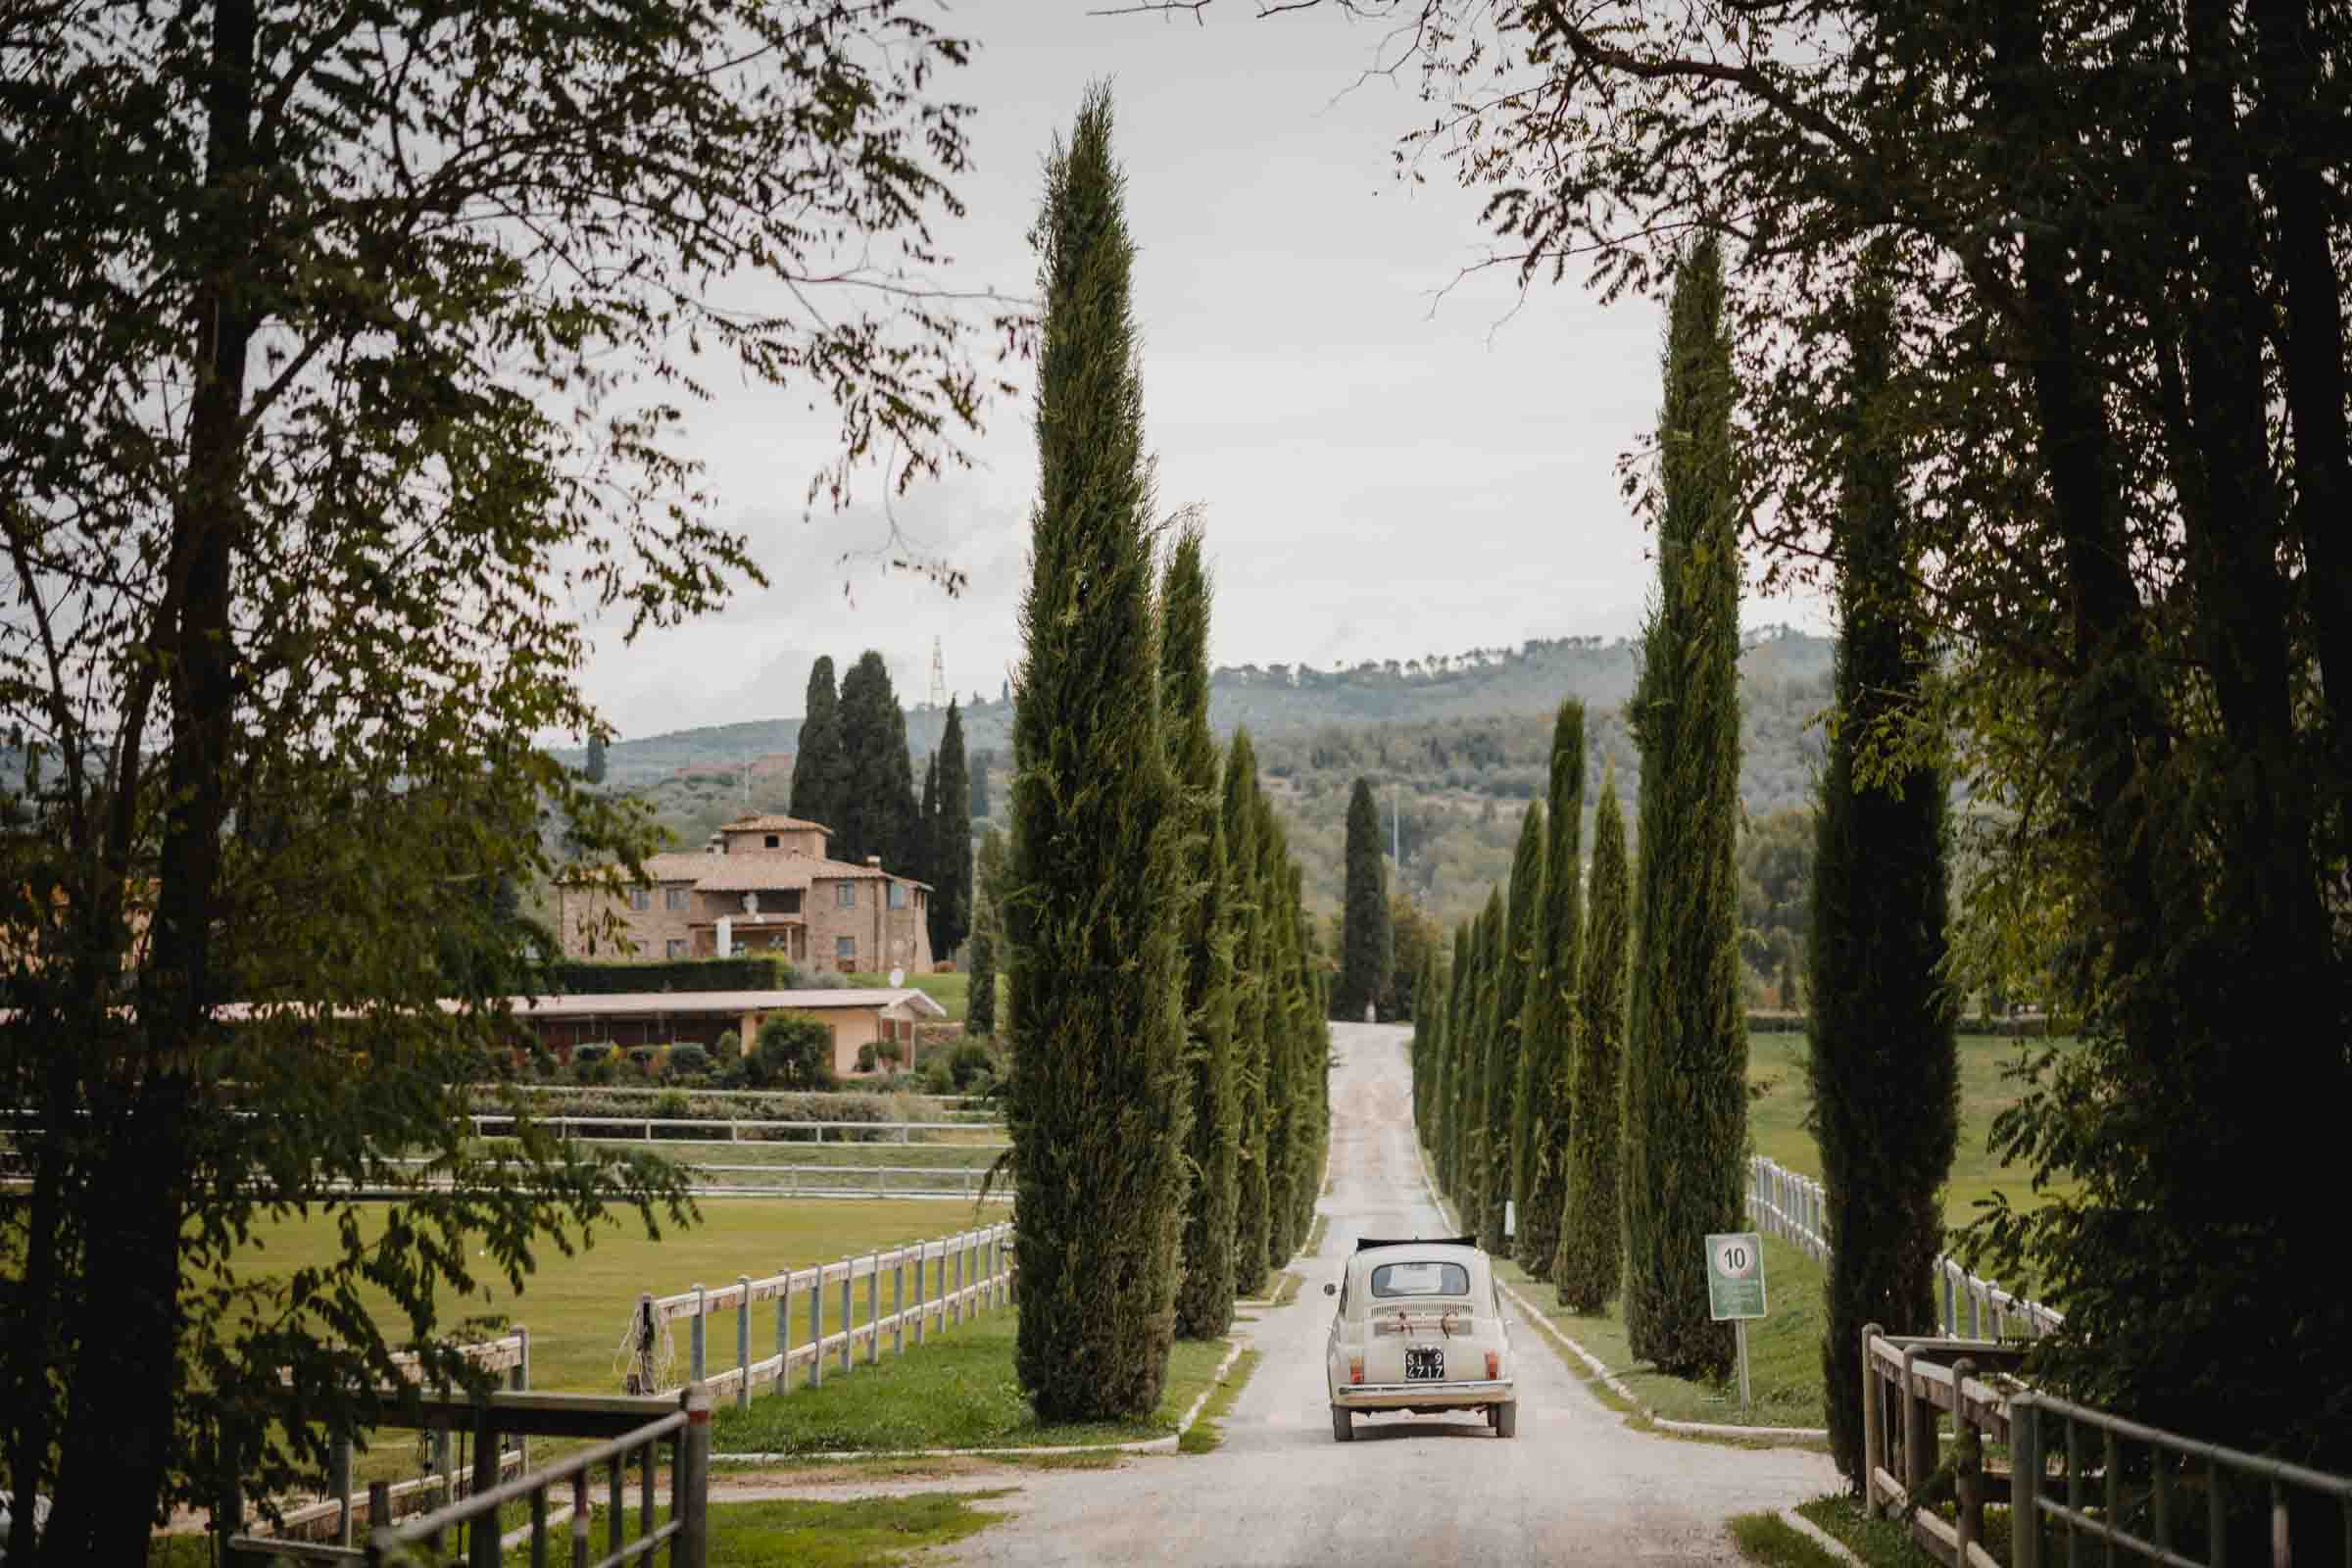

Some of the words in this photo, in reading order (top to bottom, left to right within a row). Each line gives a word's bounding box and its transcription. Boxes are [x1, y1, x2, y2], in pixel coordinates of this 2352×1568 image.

[1725, 1248, 1745, 1269] 10
[1407, 1354, 1421, 1365] SI
[1435, 1352, 1443, 1365] 9
